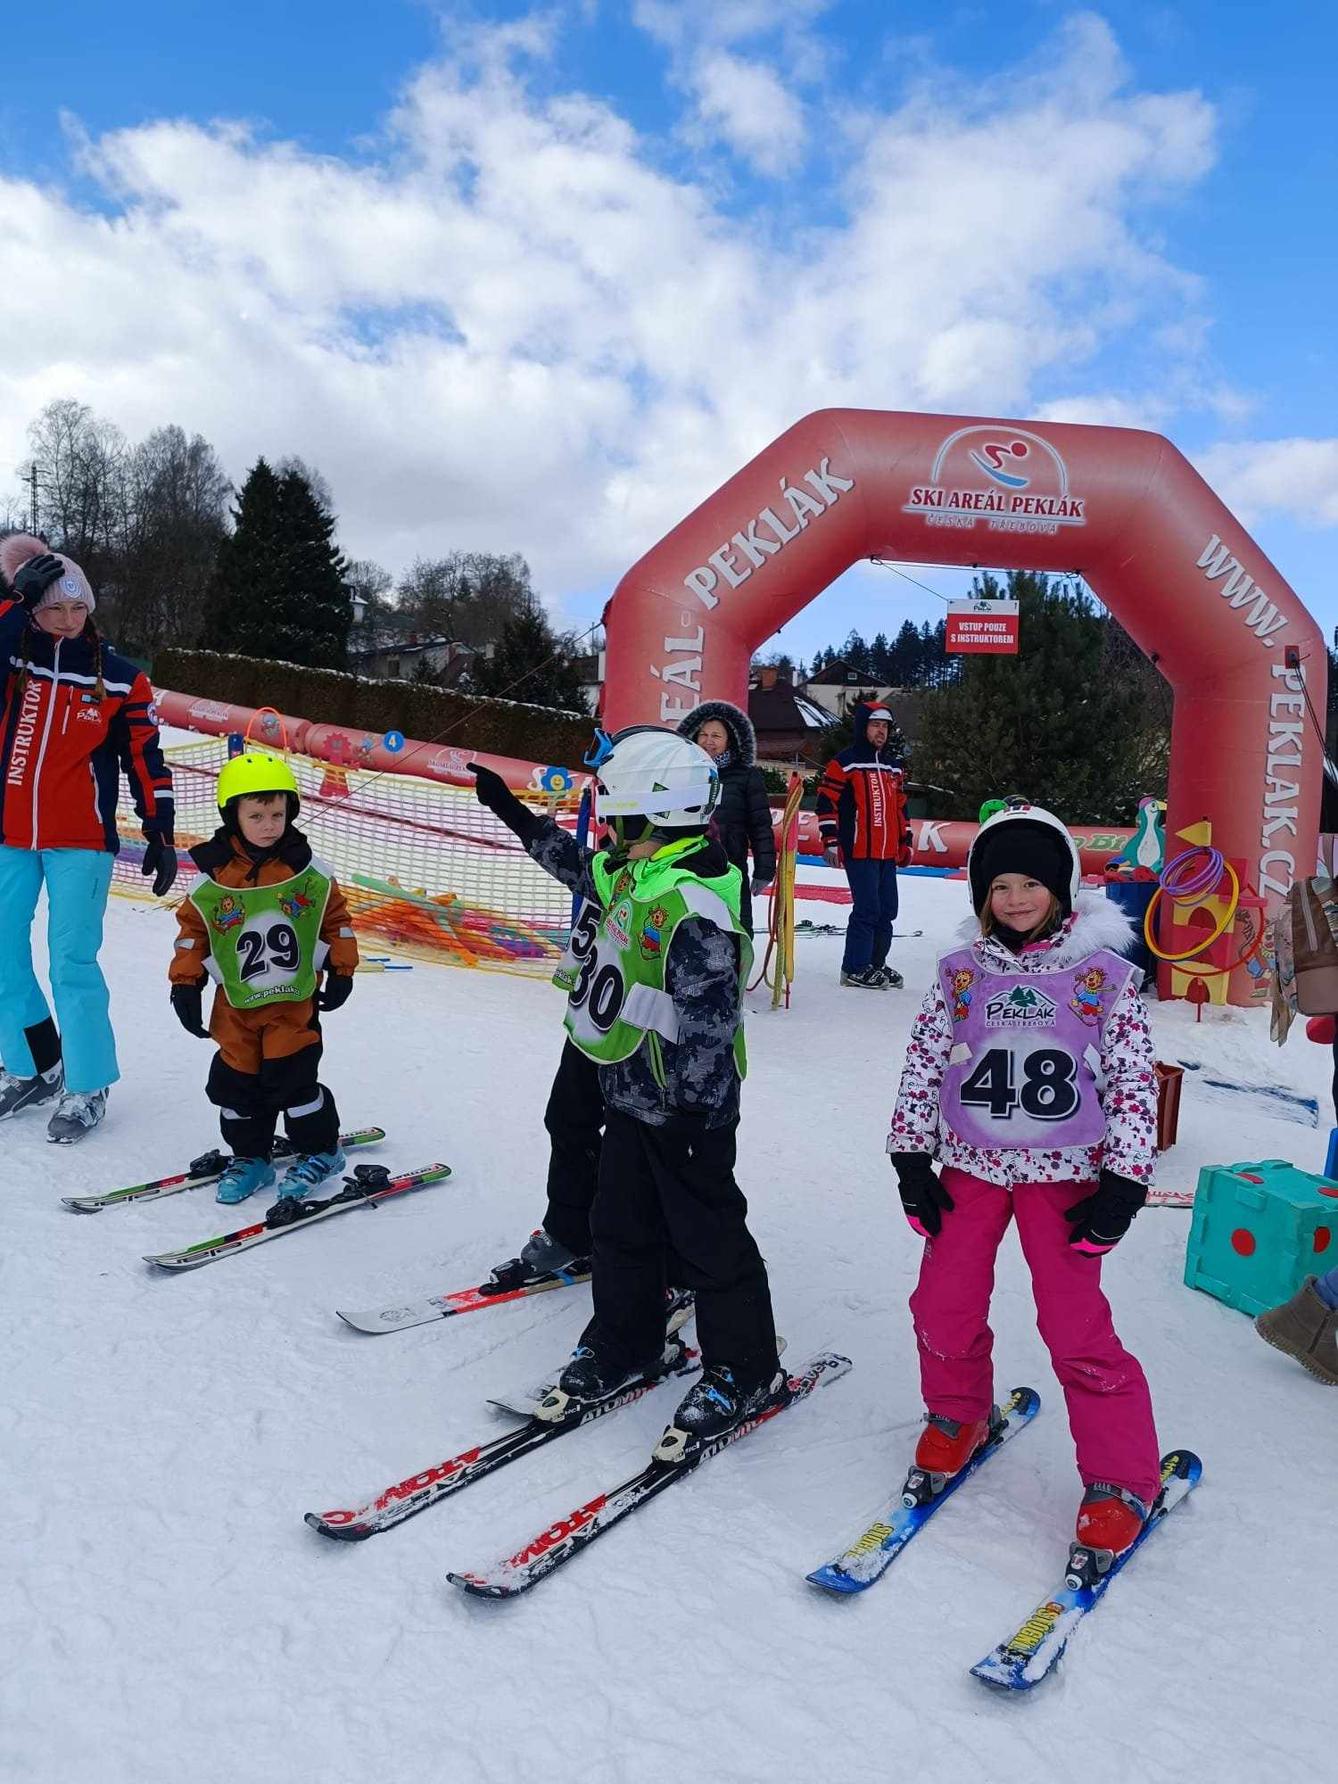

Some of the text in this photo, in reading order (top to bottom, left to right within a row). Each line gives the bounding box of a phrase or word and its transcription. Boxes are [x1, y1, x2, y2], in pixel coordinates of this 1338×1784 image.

[911, 488, 1085, 518] SKI AREÁL PEKLÁK
[648, 456, 855, 723] EÁL PEKLÁK
[950, 633, 1014, 644] S INSTRUKTOREM
[958, 622, 1007, 632] VSTUP POUZE
[8, 679, 42, 786] INSTRUKTOR
[388, 734, 397, 748] 4
[869, 772, 882, 827] INSTRUKTOR
[1259, 663, 1306, 899] PEKLAK.CZ
[235, 924, 300, 983] 29
[569, 944, 625, 1031] 30
[960, 1049, 1081, 1121] 48
